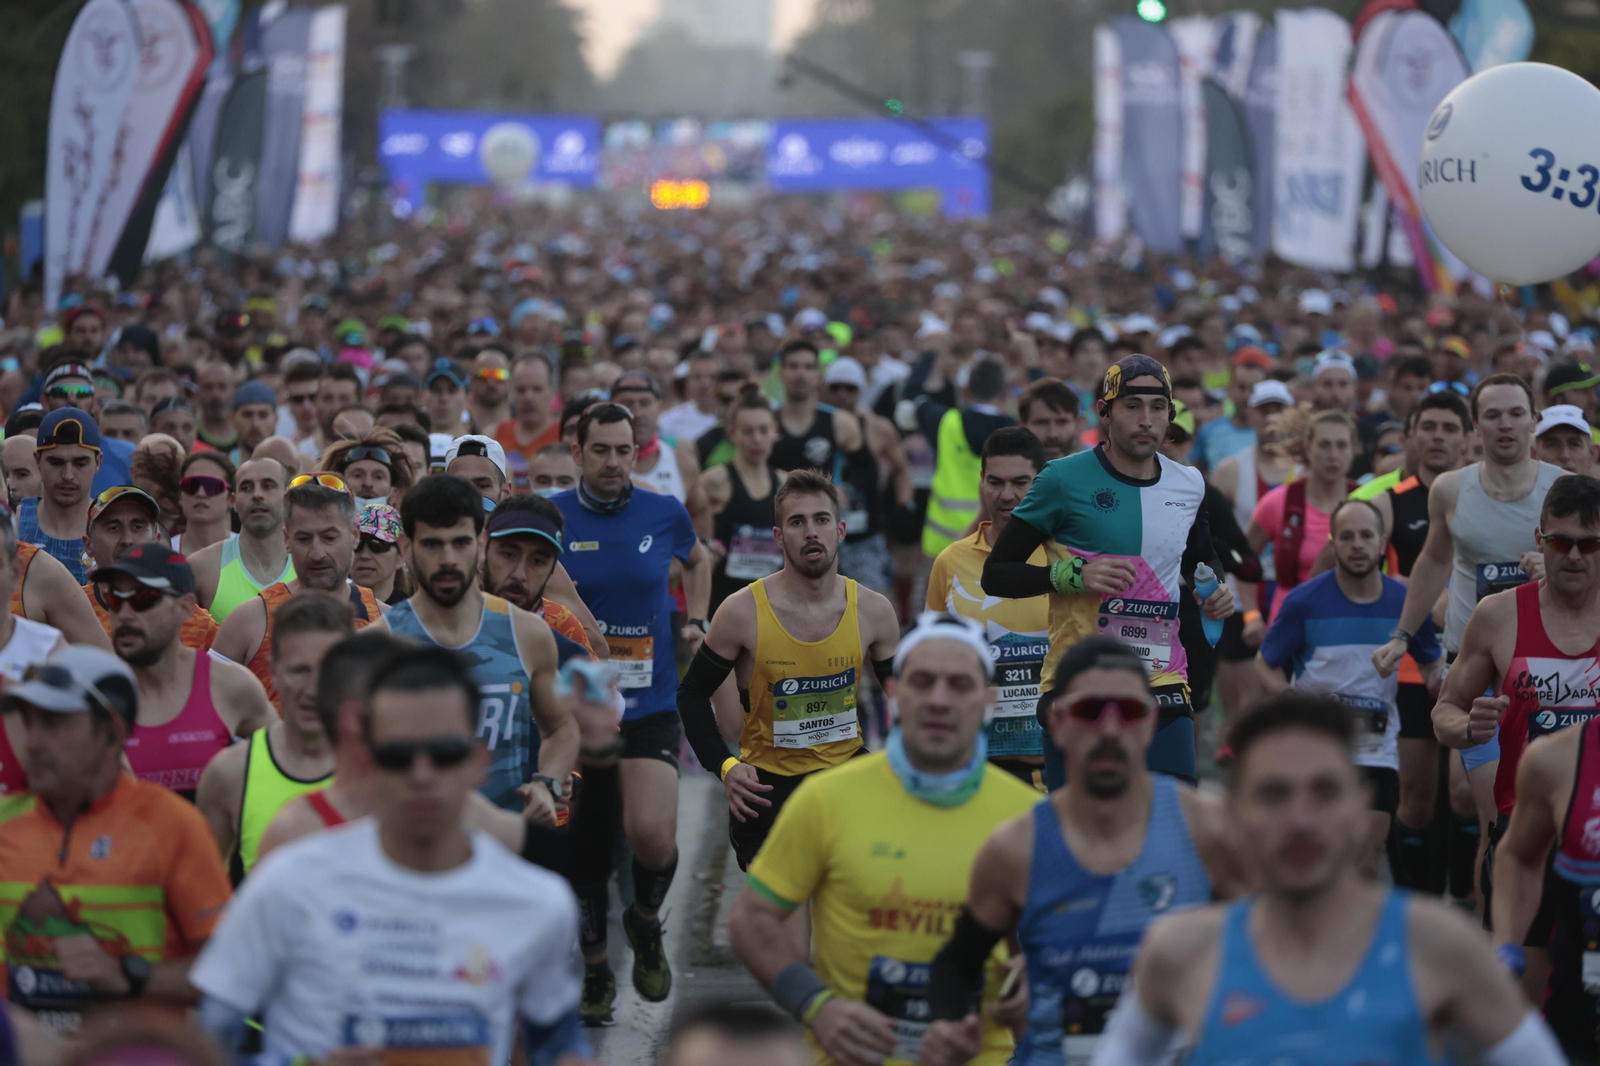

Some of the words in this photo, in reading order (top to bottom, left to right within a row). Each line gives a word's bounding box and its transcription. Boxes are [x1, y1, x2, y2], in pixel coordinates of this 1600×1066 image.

[1418, 157, 1476, 189] RICH
[1520, 147, 1600, 215] 3:3
[1125, 603, 1168, 615] ZURICH
[609, 625, 648, 636] ZURICH
[1121, 625, 1147, 639] 6899
[1003, 645, 1049, 657] ZURICH
[1130, 646, 1150, 657] ONIO
[1005, 668, 1032, 681] 3211
[801, 674, 848, 690] ZURICH
[1003, 687, 1038, 698] LUCANO
[1515, 690, 1553, 701] ROMPE
[806, 701, 827, 714] 897
[799, 717, 835, 731] SANTOS
[994, 720, 1043, 733] GLOBA
[868, 908, 950, 936] SEVIL
